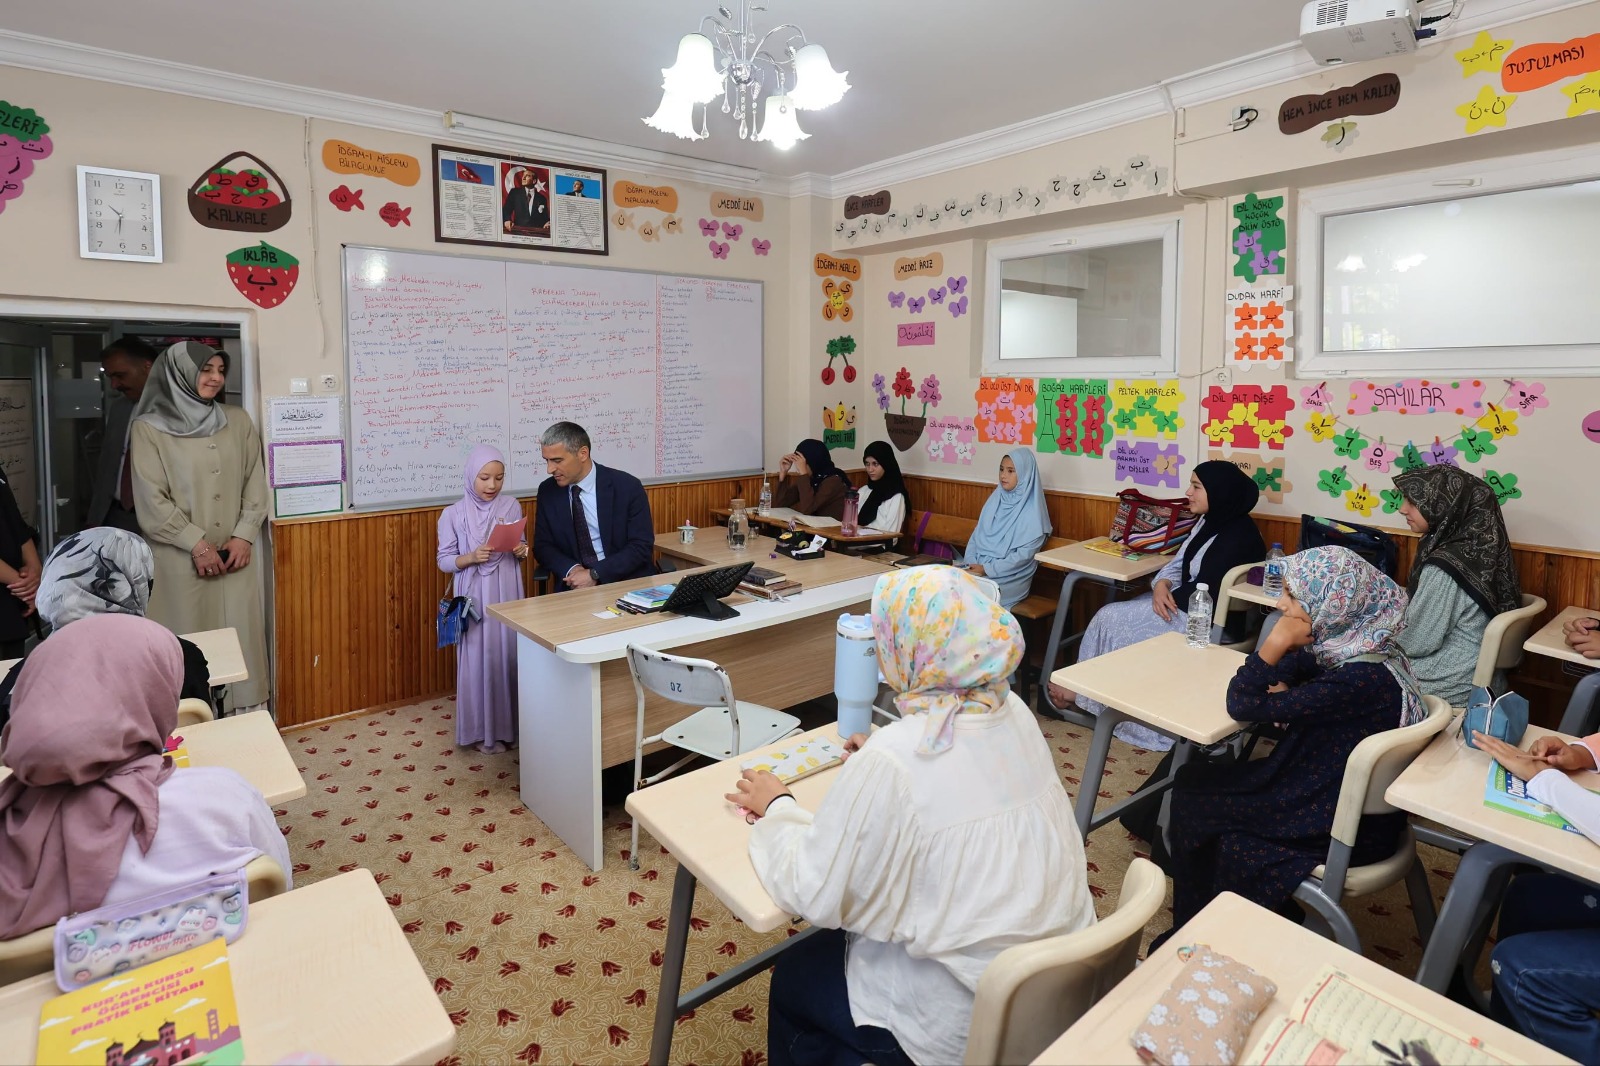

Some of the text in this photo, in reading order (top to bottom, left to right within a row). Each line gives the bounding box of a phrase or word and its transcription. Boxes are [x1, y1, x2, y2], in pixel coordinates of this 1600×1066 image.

[1506, 45, 1585, 75] TUTULMASI
[1283, 81, 1400, 122] HEM İNCE HEM KALIN
[1130, 160, 1144, 170] ب
[94, 198, 102, 206] 10
[1237, 202, 1249, 213] DİL
[207, 208, 268, 226] KALKALE
[96, 221, 102, 229] 8
[1238, 222, 1257, 233] DİLİN
[141, 243, 147, 251] 5
[247, 274, 278, 291] ب
[1227, 287, 1284, 301] DUDAK HARFİ
[1069, 384, 1106, 395] HARFLERİ
[1118, 387, 1177, 396] PELTEK HARFLER
[1212, 392, 1275, 405] DİL ALT DİŞE
[1374, 387, 1446, 407] SAYILAR
[1519, 394, 1539, 410] SIFIR
[1494, 424, 1510, 435] BİR
[1118, 447, 1126, 455] DİL
[1139, 456, 1150, 464] ÜST
[1369, 458, 1382, 469] BEŞ
[359, 464, 376, 472] 610
[1129, 465, 1149, 474] DİŞLER
[81, 966, 195, 1014] KUR'AN KURSU
[70, 980, 204, 1036] PRATİK EL KİTABI
